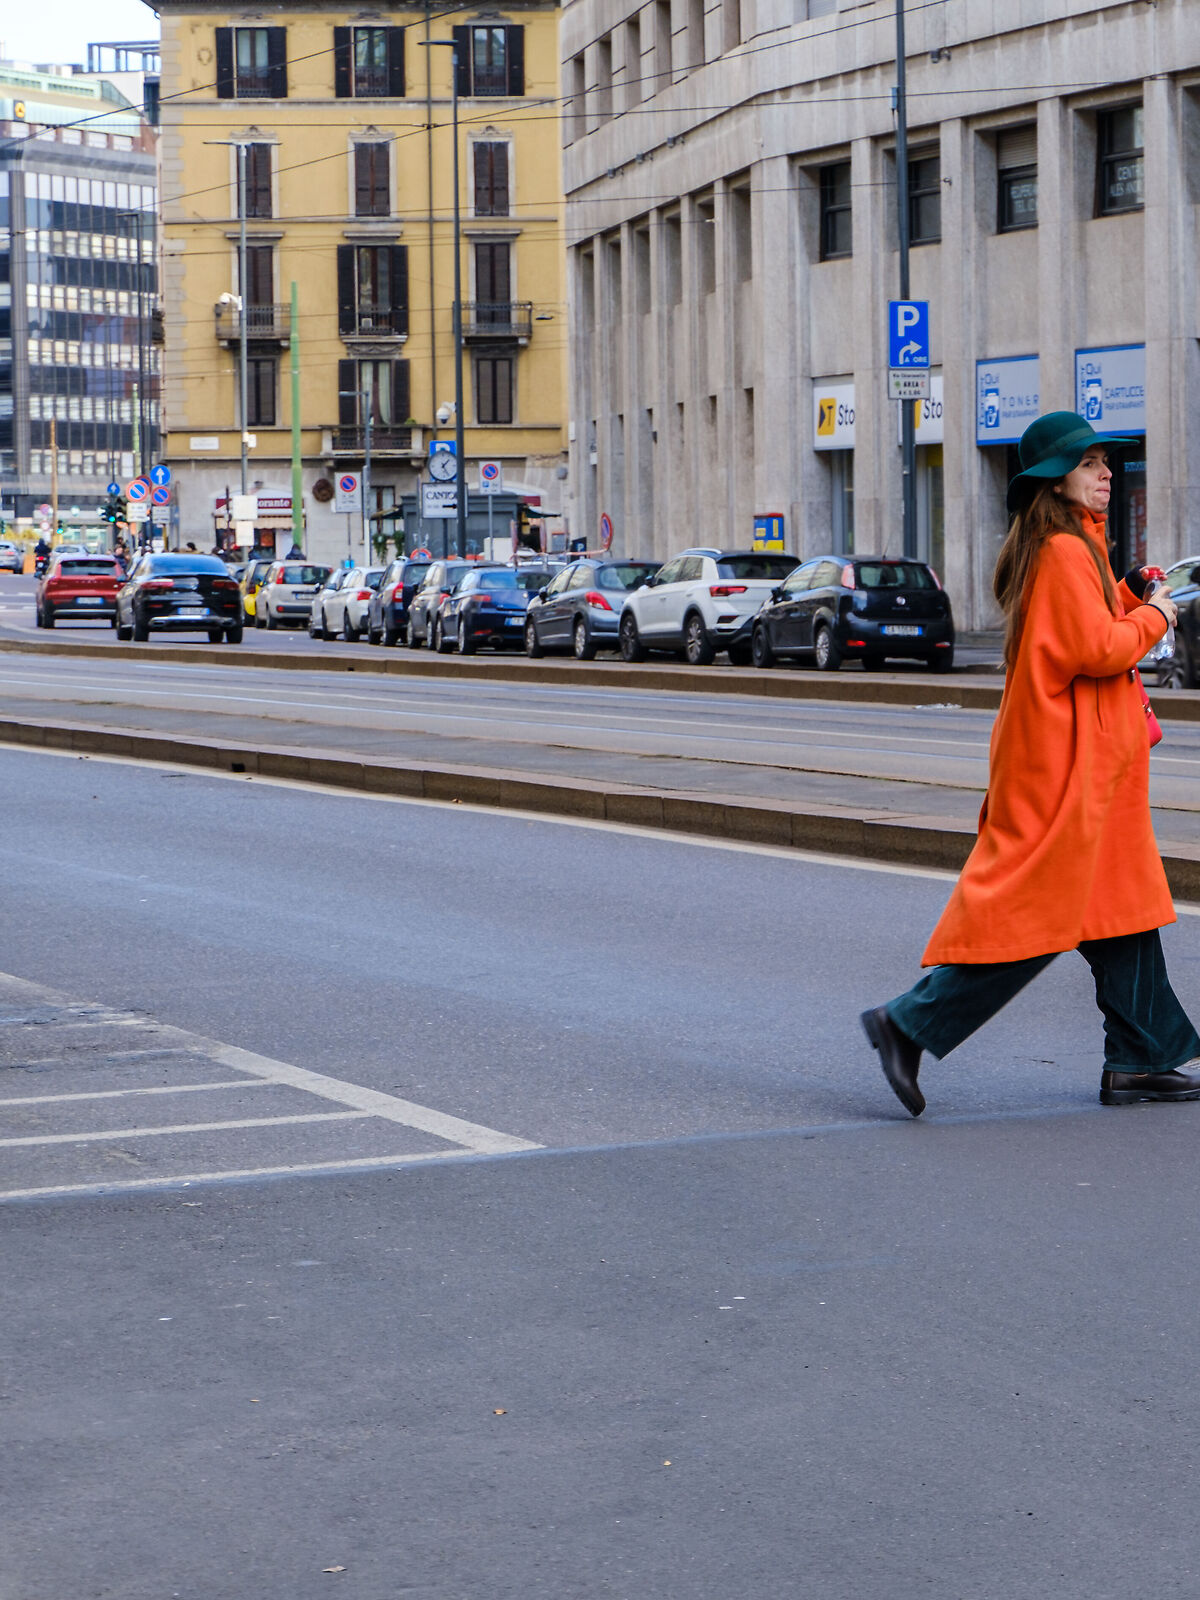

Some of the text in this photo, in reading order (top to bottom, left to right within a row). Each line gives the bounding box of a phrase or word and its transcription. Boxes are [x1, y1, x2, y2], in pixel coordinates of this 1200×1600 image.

[897, 305, 920, 337] P
[1104, 385, 1145, 399] CARTUCCE
[1001, 393, 1039, 407] TONER
